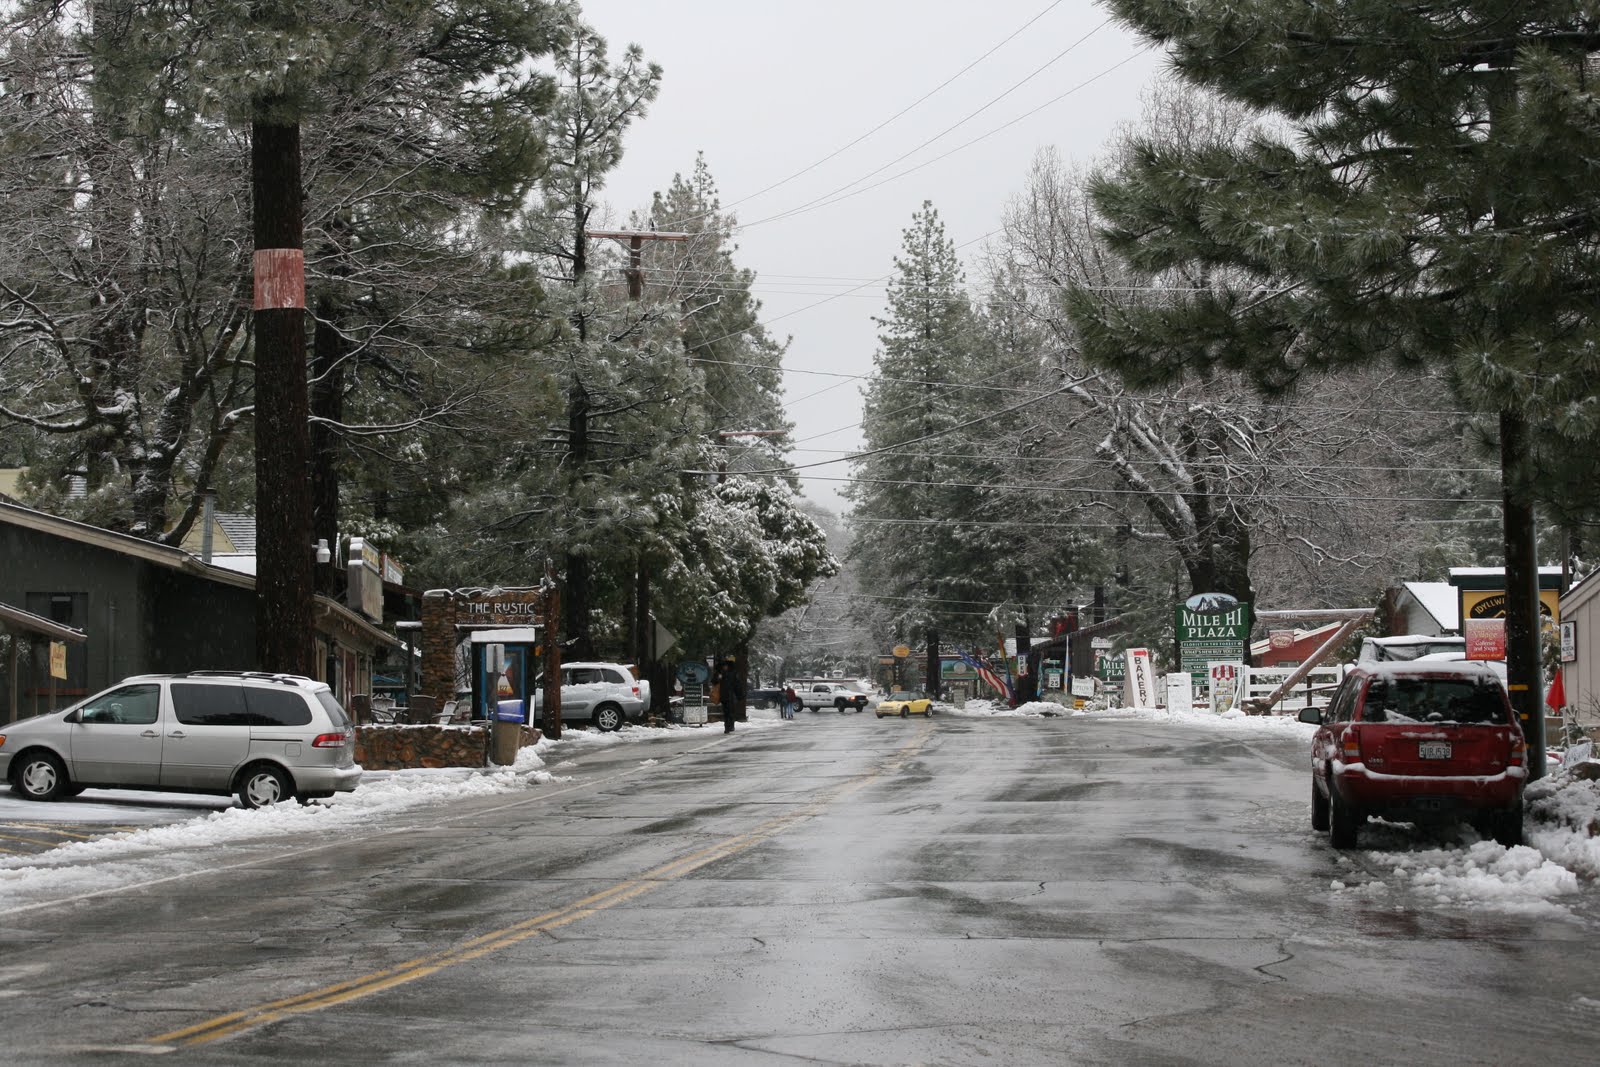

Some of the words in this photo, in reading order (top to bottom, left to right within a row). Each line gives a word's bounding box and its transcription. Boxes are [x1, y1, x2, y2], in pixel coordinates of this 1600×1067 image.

[468, 602, 491, 614] THE
[494, 602, 535, 614] RUSTIC
[1182, 609, 1221, 627] MILE
[1225, 607, 1243, 626] HI
[1188, 627, 1237, 638] PLAZA
[1103, 659, 1125, 669] MILE
[1134, 656, 1147, 706] BAKERY
